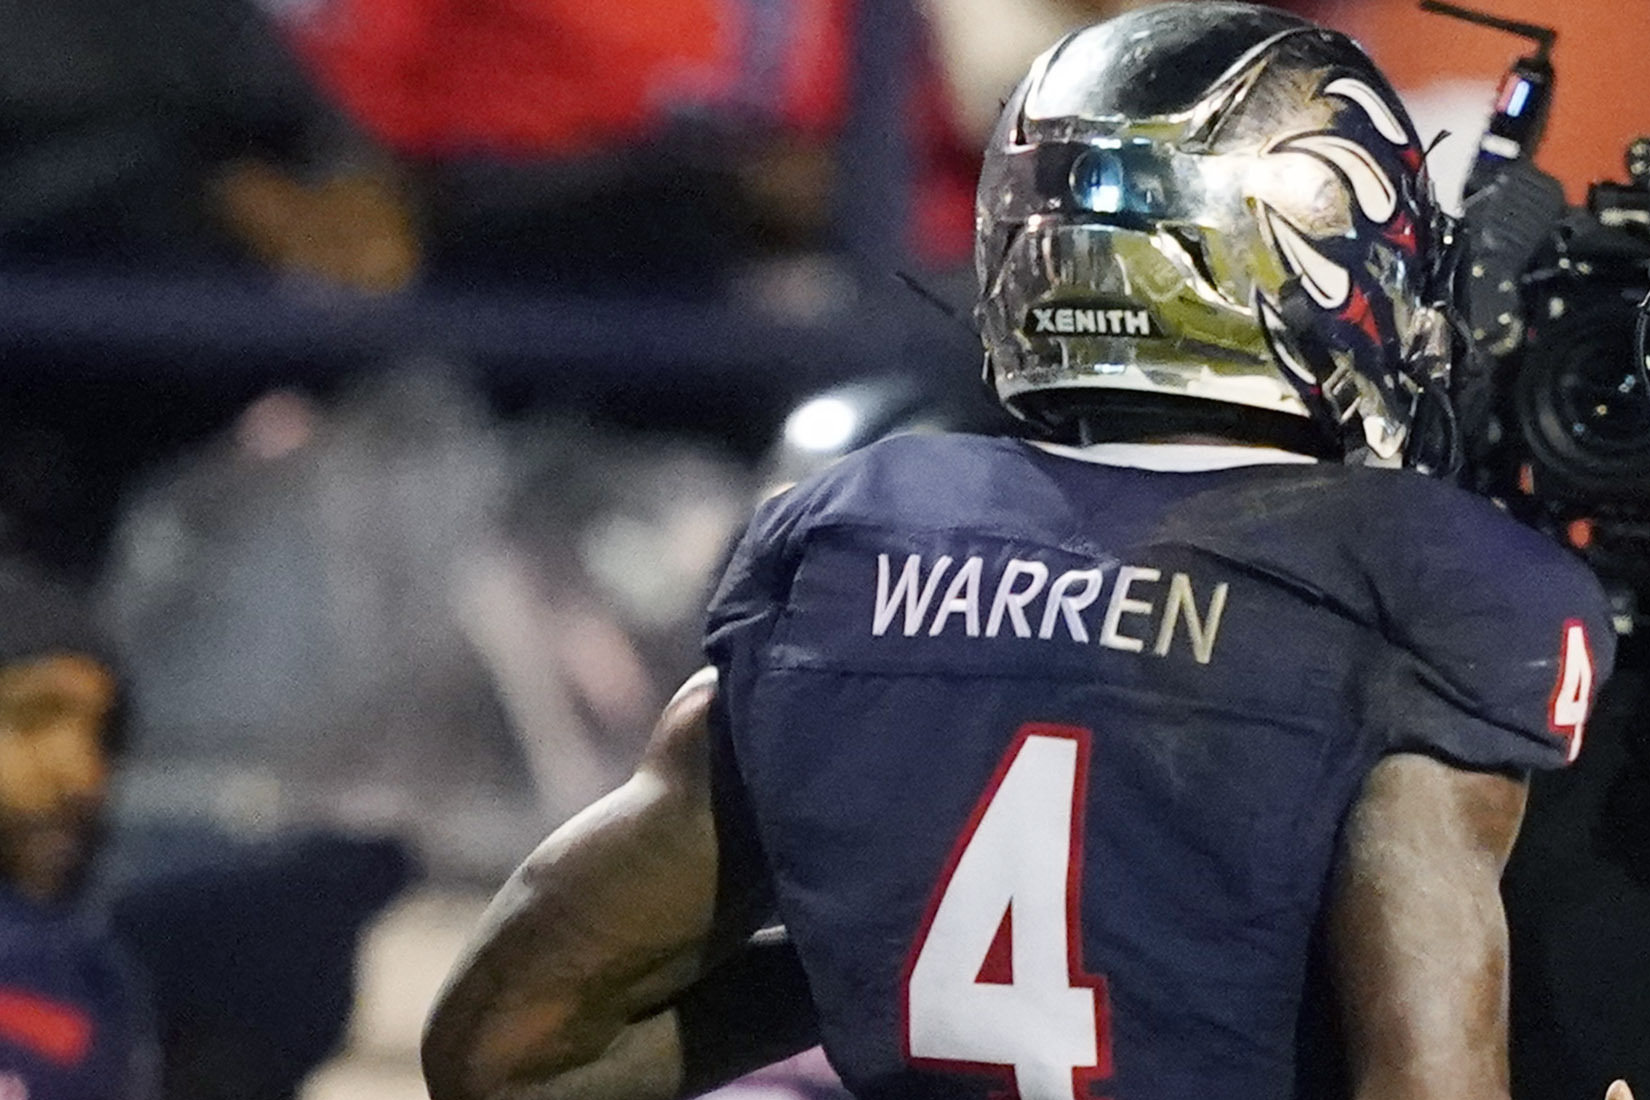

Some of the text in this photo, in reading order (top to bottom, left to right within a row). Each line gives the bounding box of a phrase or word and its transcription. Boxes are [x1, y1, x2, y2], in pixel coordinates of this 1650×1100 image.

[1033, 308, 1150, 335] XENITH
[872, 553, 1228, 664] WARREN
[1548, 618, 1596, 765] 4
